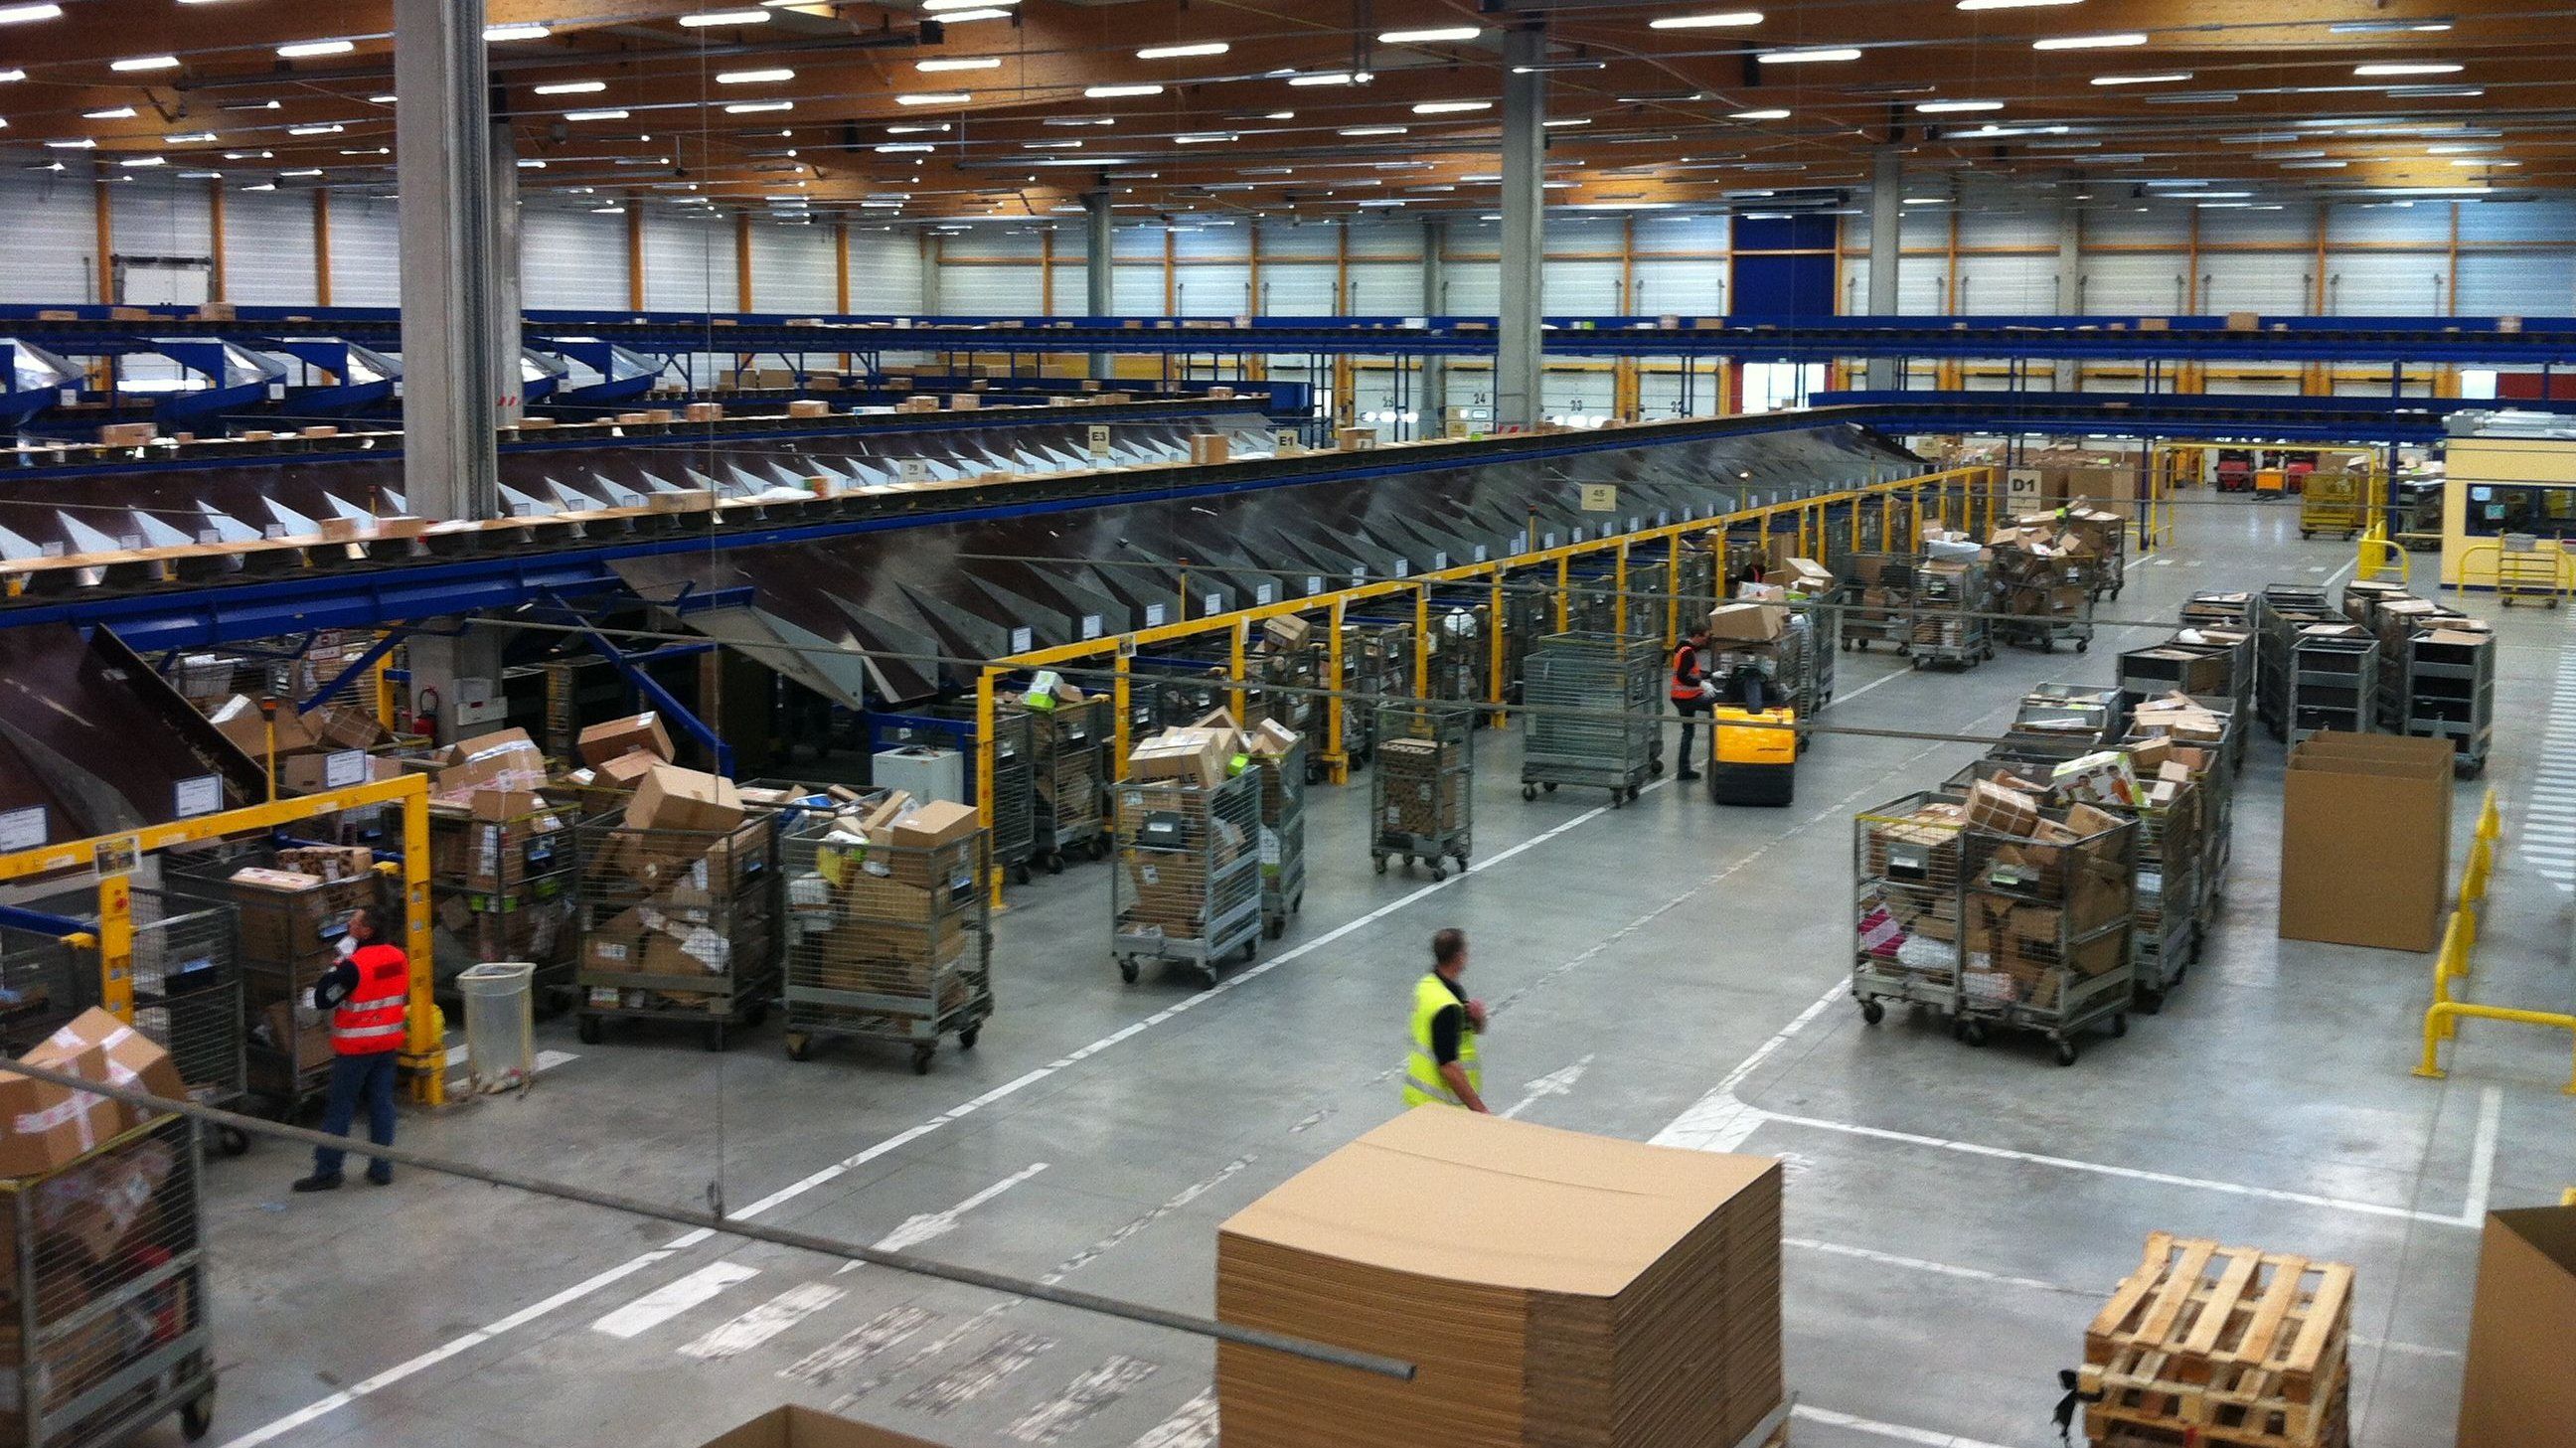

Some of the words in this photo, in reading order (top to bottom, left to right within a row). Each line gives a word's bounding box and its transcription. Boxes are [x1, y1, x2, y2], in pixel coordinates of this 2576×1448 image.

[1474, 394, 1486, 404] 24
[1570, 400, 1583, 411] 23
[1092, 431, 1106, 441] E3
[1279, 436, 1294, 446] E1
[2012, 479, 2035, 492] D1
